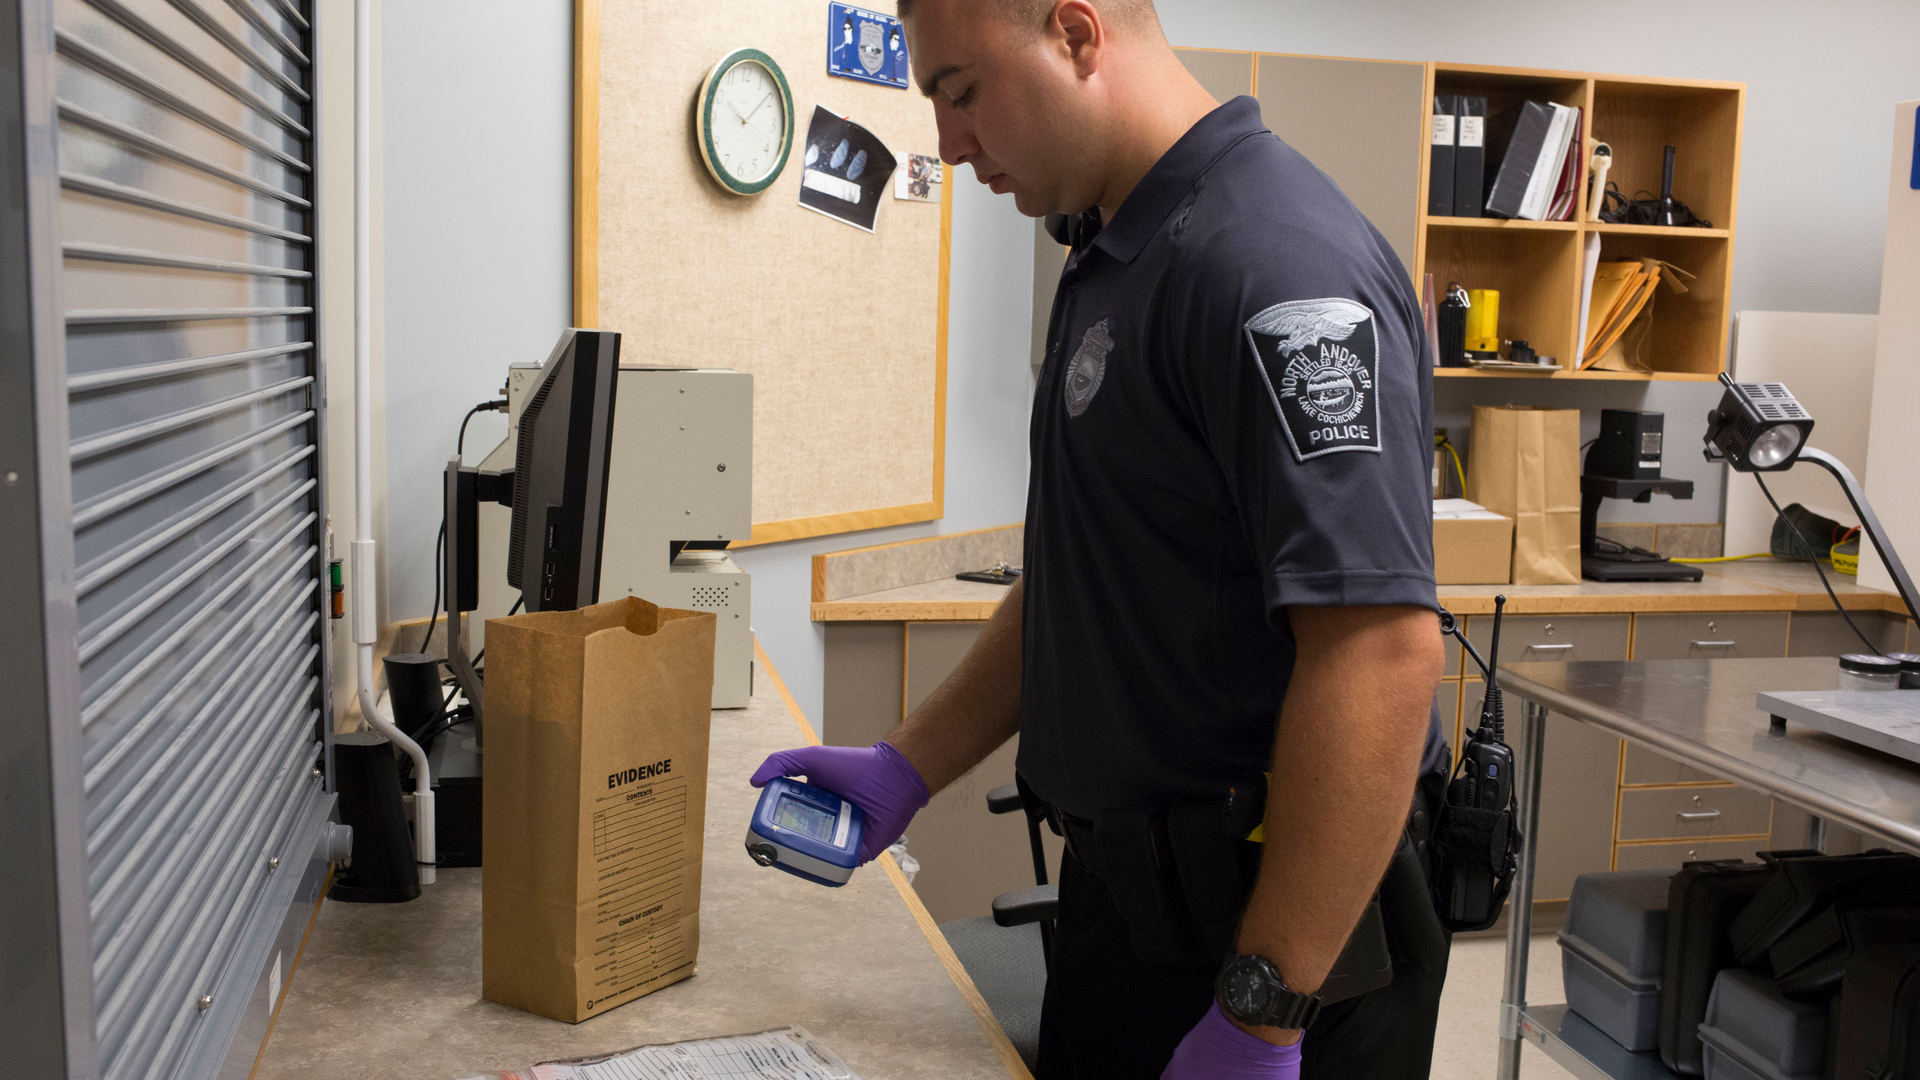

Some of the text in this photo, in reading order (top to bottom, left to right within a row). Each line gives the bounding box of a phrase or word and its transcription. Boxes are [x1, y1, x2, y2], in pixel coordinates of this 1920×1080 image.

[727, 70, 735, 85] 11
[742, 66, 752, 82] 12
[766, 91, 774, 108] 2
[769, 118, 776, 133] 3
[763, 142, 770, 157] 4
[724, 153, 730, 168] 7
[751, 159, 757, 174] 5
[737, 162, 744, 177] 6
[1280, 343, 1372, 399] NORTH ANDOVER
[1300, 358, 1331, 380] SETTLED
[1298, 391, 1365, 424] LAKE COCHICHEWICK
[1309, 425, 1370, 445] POLICE
[608, 758, 672, 790] EVIDENCE
[626, 789, 652, 801] CONTENTS
[619, 916, 634, 926] CHAIN
[642, 904, 663, 917] CUSTODY
